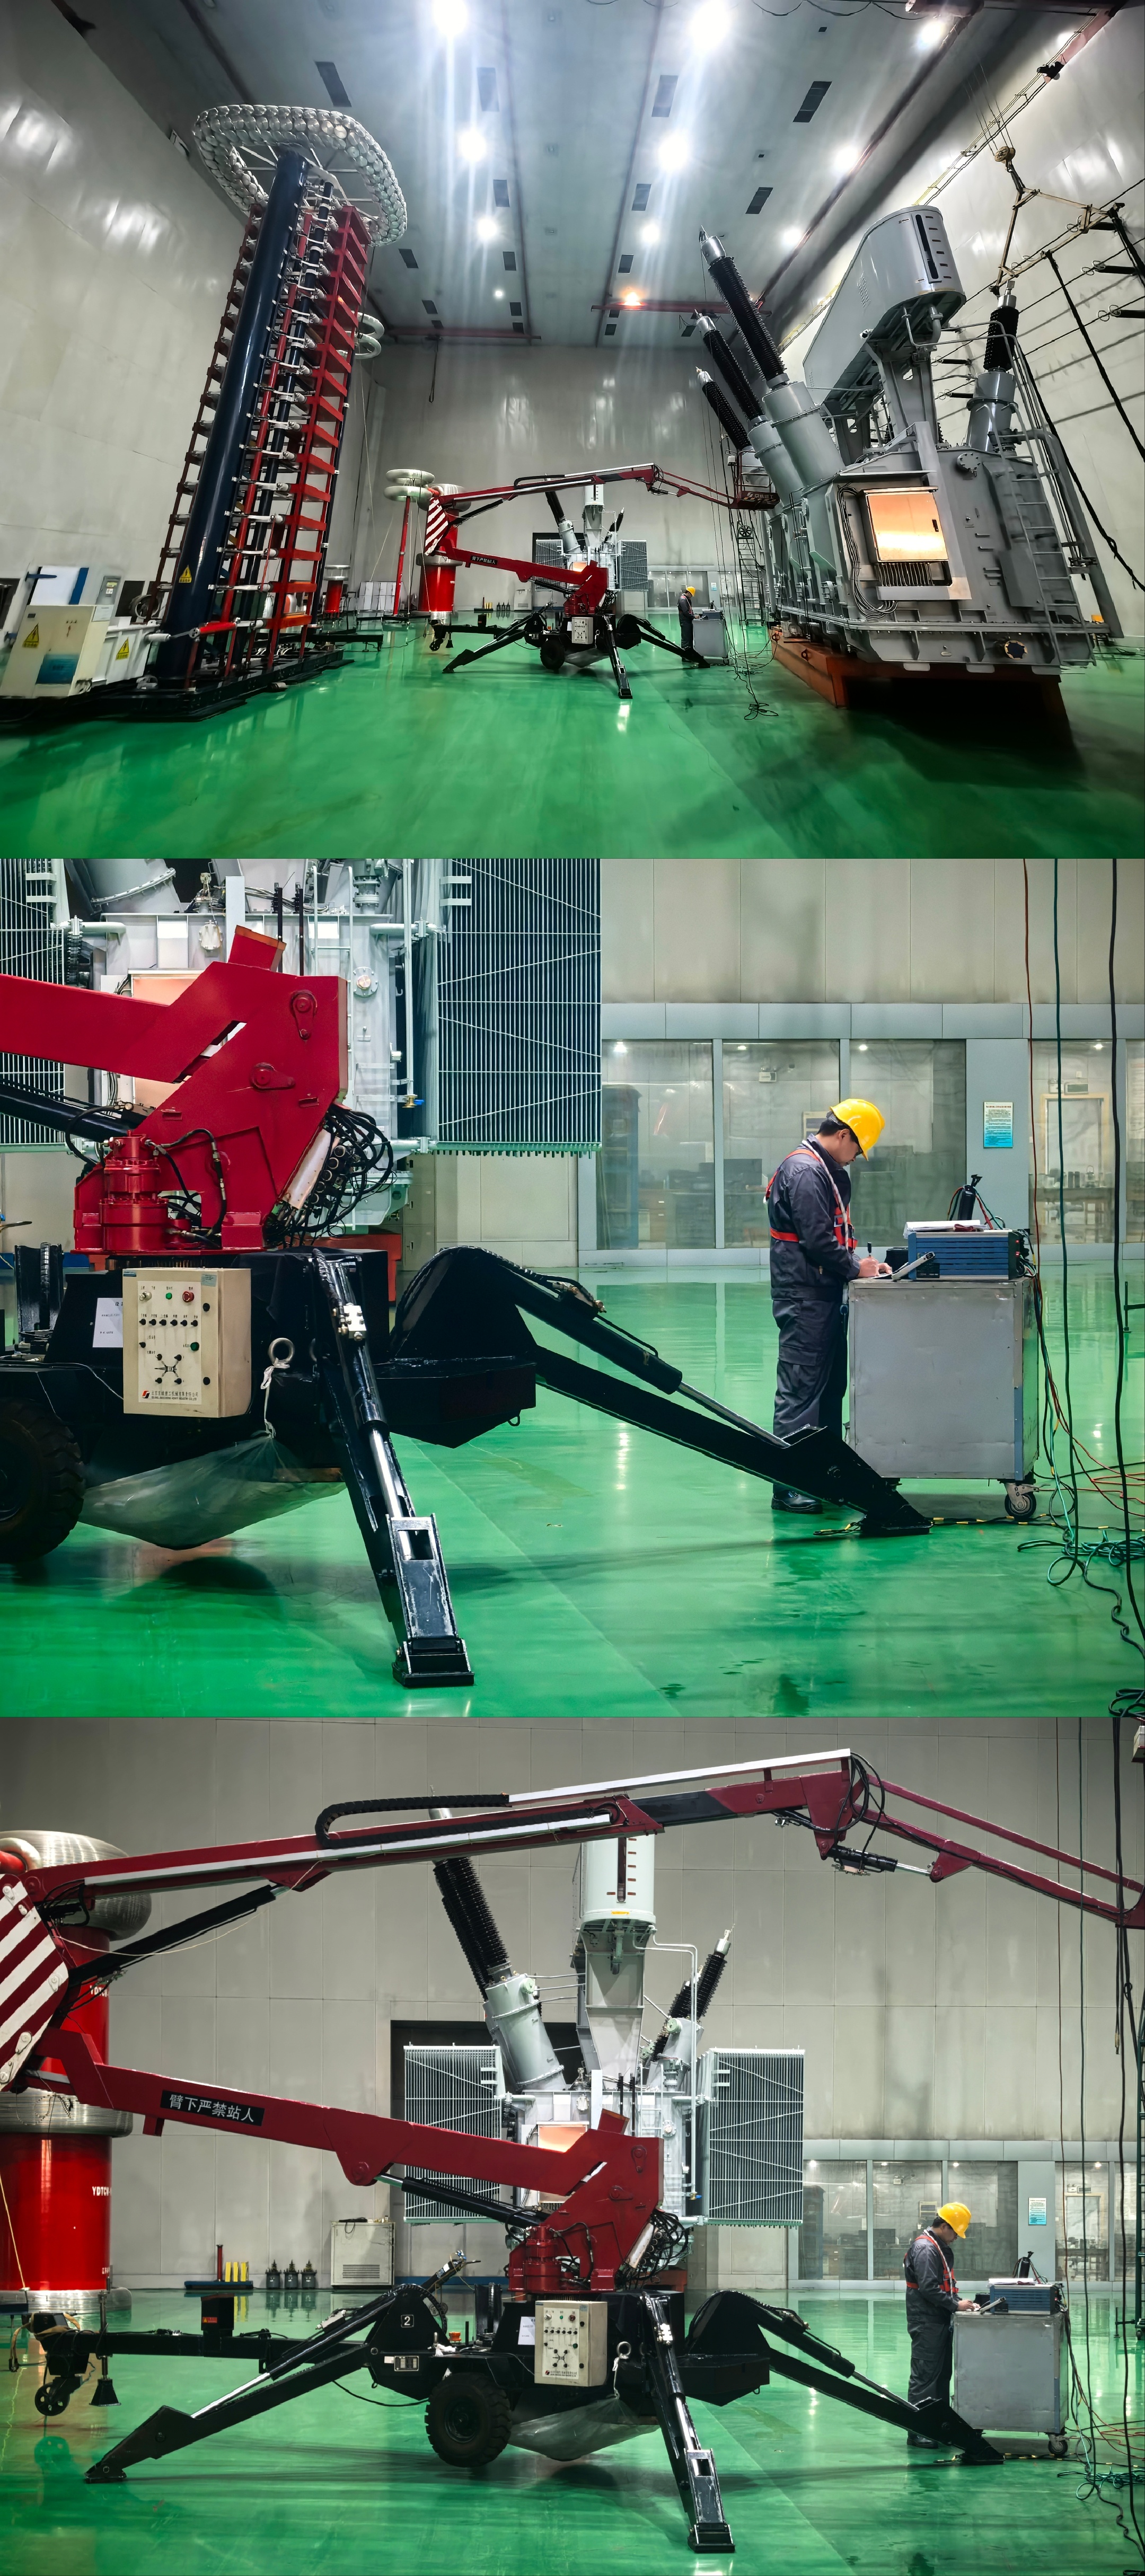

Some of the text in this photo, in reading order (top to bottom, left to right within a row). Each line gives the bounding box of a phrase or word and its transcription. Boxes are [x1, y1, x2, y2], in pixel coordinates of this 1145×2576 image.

[170, 2094, 254, 2122] 臂下严禁站人
[404, 2316, 410, 2326] 2
